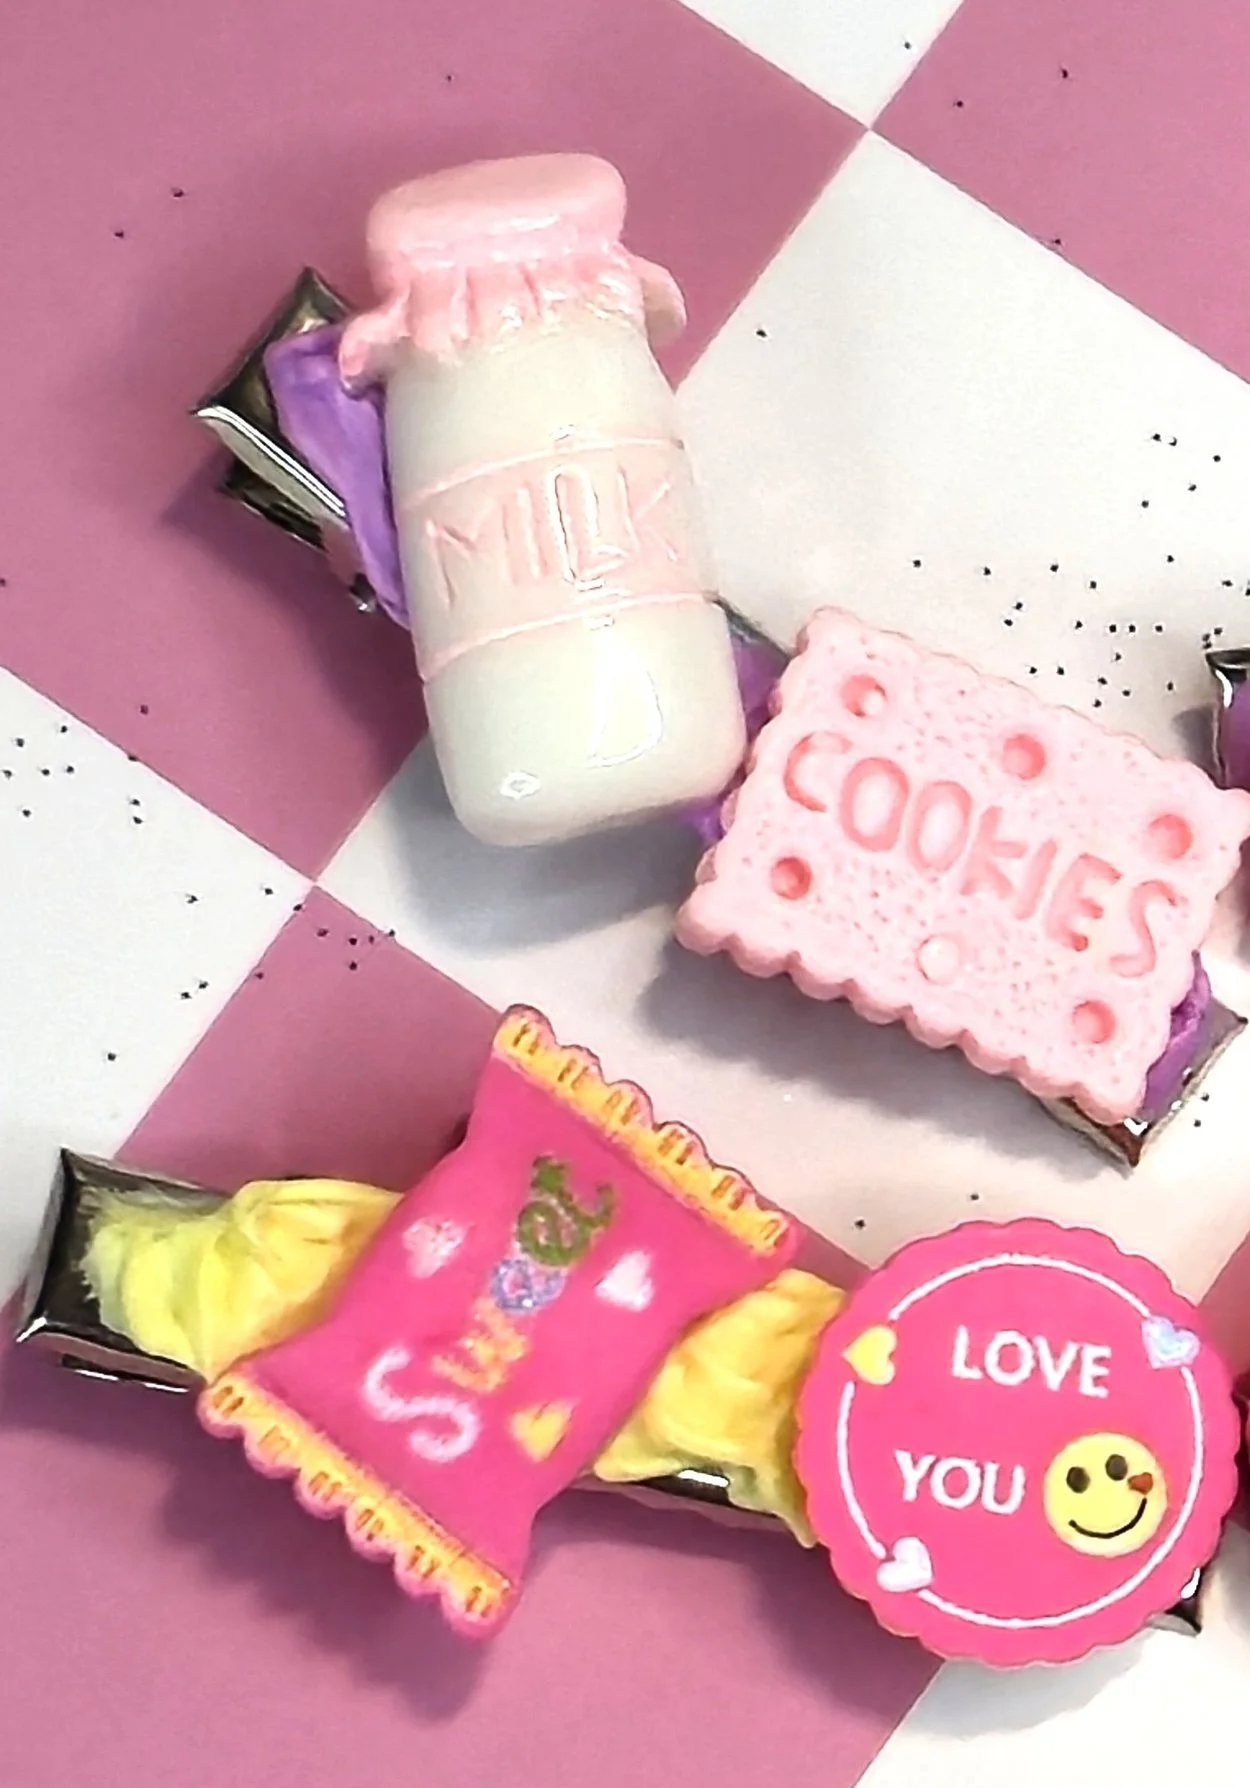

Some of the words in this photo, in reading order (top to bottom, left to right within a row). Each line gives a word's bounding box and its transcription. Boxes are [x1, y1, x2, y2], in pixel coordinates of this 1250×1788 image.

[424, 465, 682, 610] MILK
[783, 731, 1182, 978] COOKIES
[952, 1325, 1112, 1398] LOVE
[895, 1450, 1026, 1515] YOU
